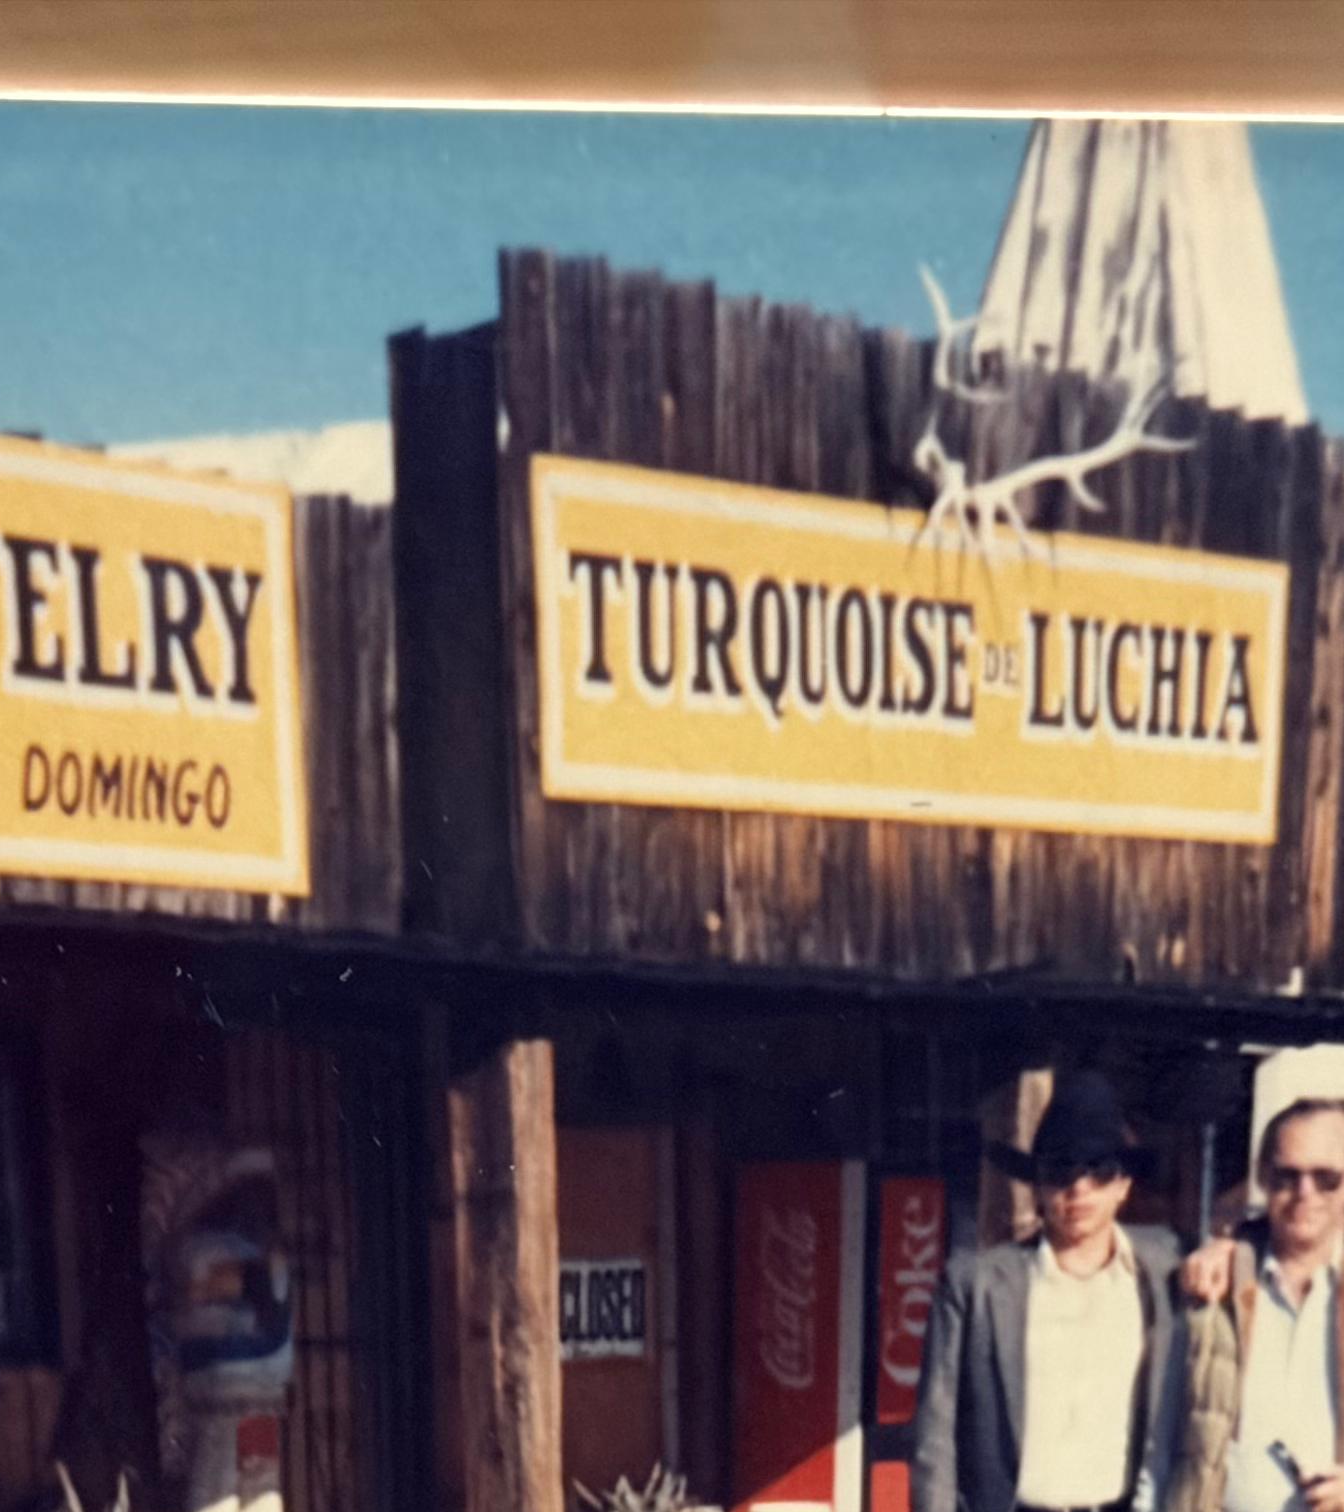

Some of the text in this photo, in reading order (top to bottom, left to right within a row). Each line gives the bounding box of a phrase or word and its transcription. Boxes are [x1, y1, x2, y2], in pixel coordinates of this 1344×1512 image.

[567, 550, 975, 720] TURQUOISE
[1027, 611, 1261, 745] LUCHIA
[22, 744, 232, 832] DOMINGO
[881, 1194, 942, 1388] Coke
